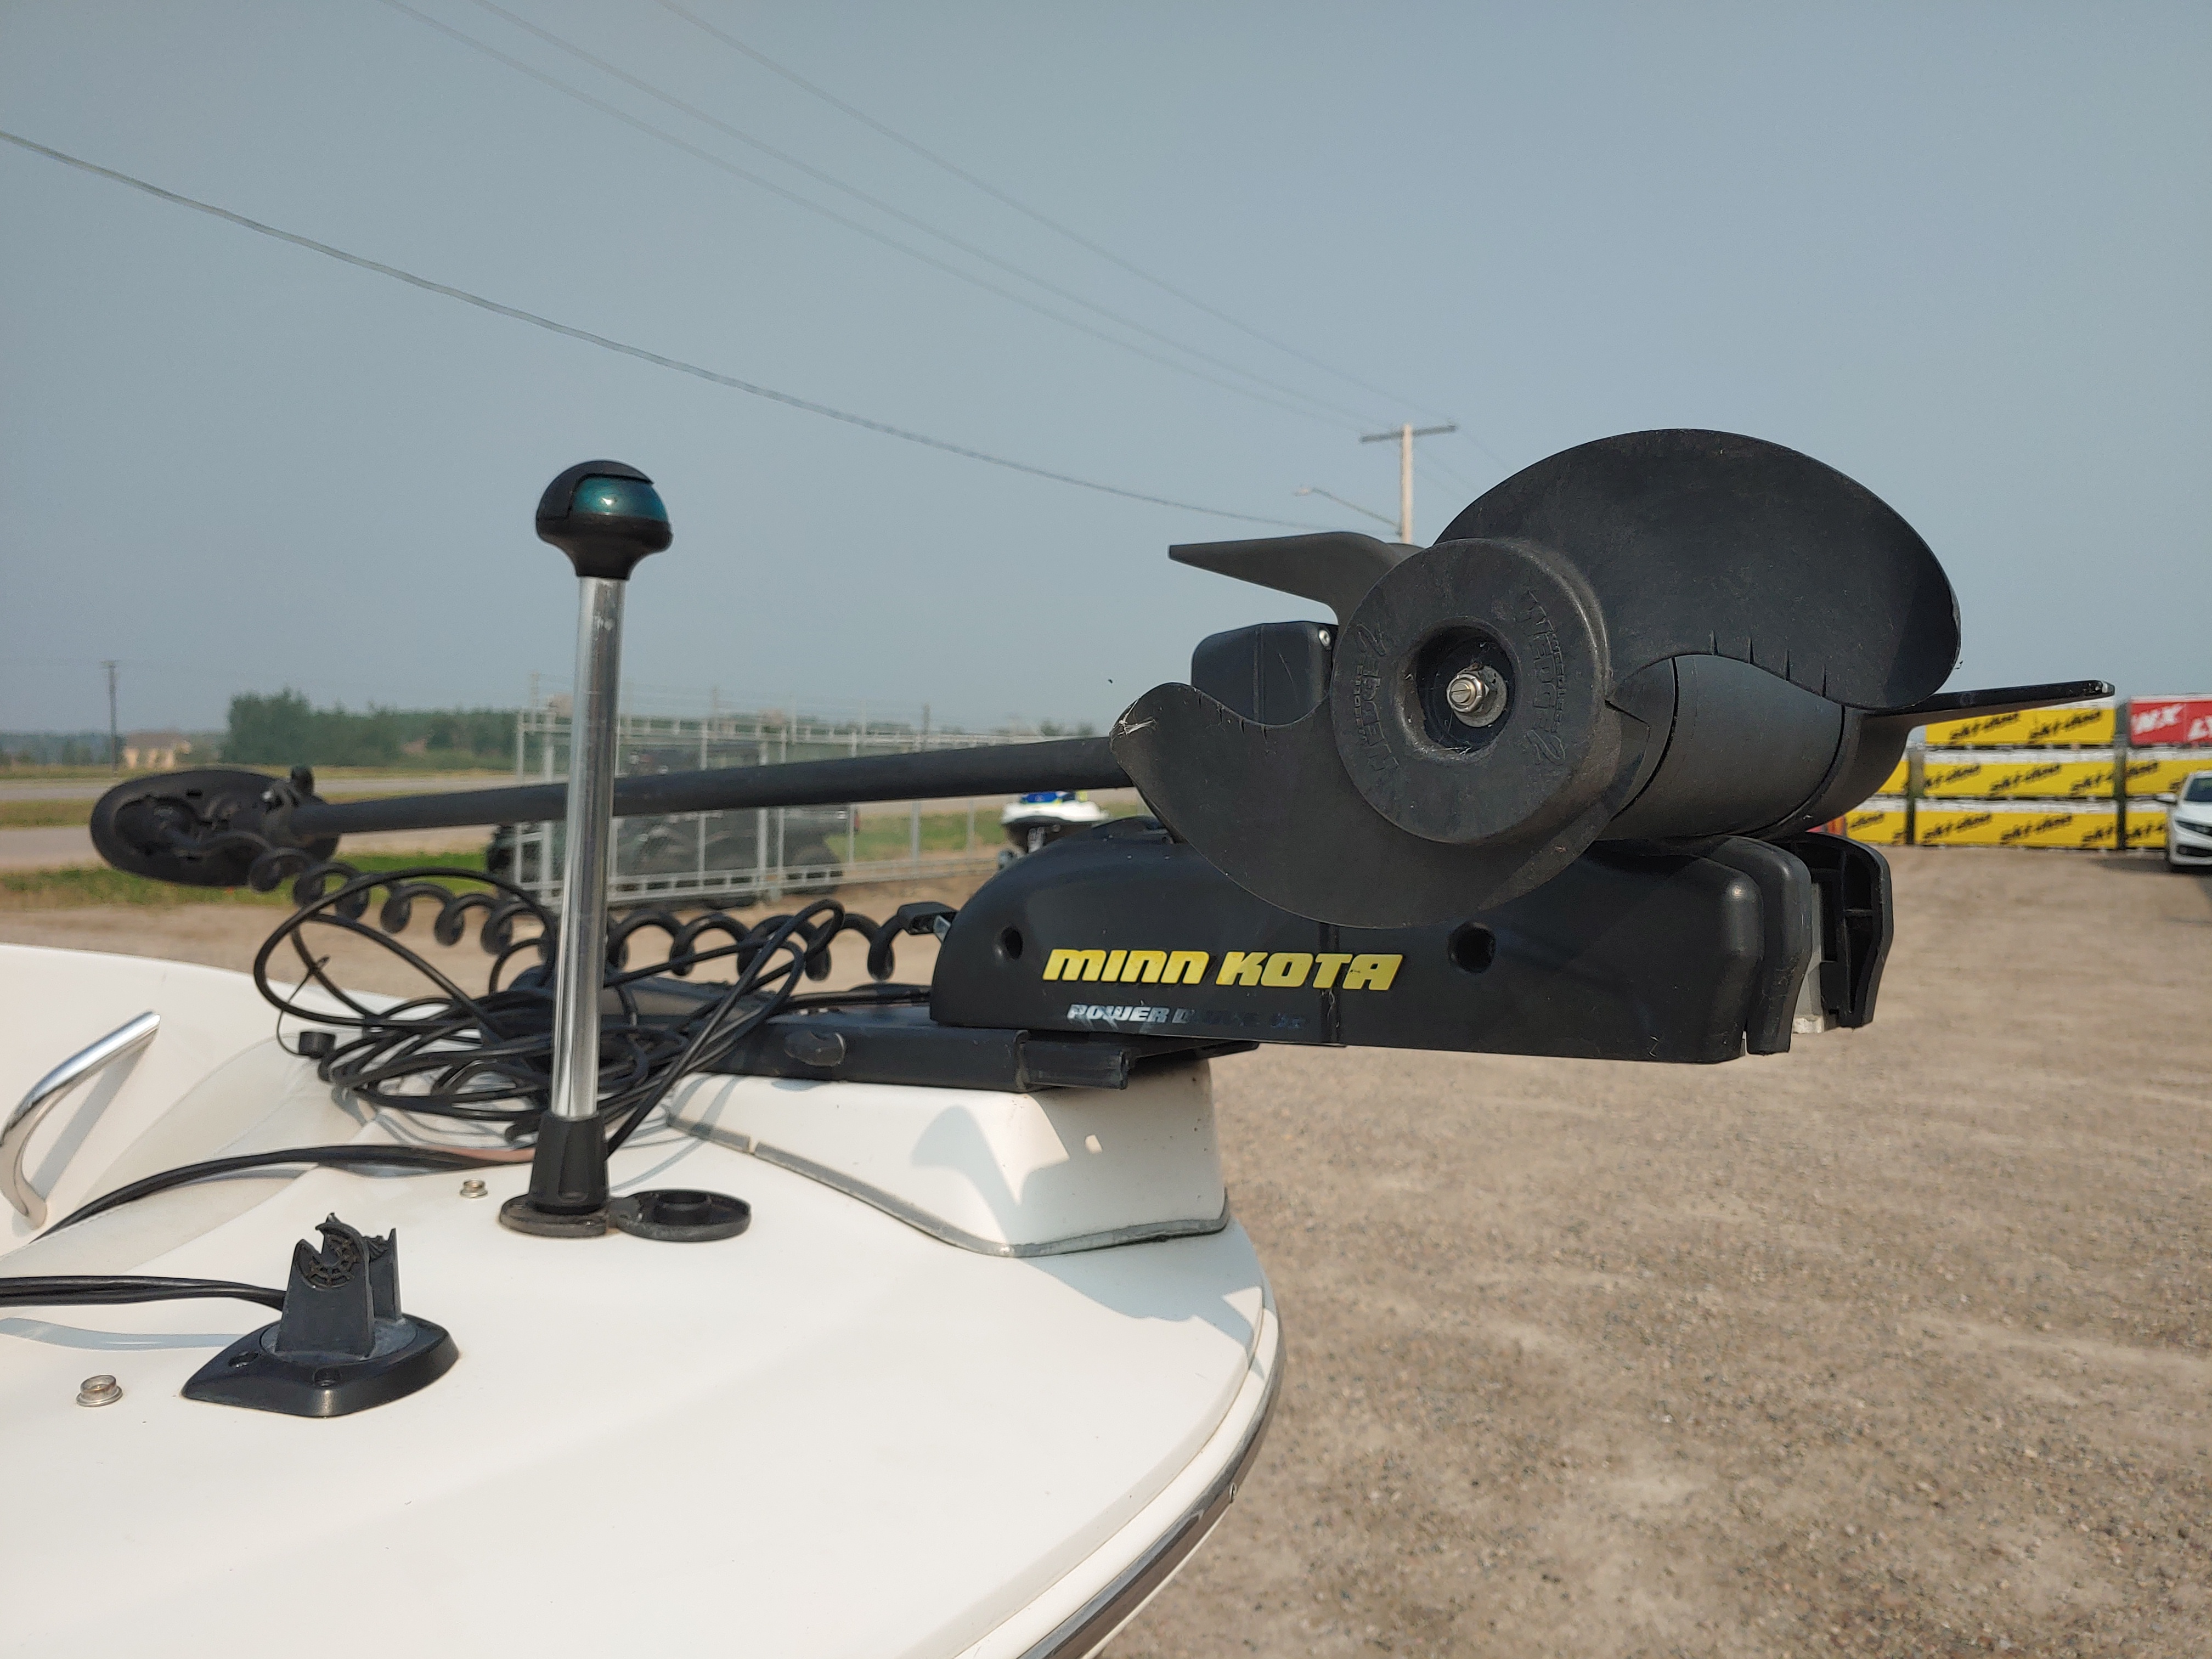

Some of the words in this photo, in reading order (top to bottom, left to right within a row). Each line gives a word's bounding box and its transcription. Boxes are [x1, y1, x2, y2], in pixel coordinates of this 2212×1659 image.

[1042, 949, 1210, 984] MINN
[1216, 951, 1403, 990] KOTA
[1068, 1003, 1170, 1023] POWER
